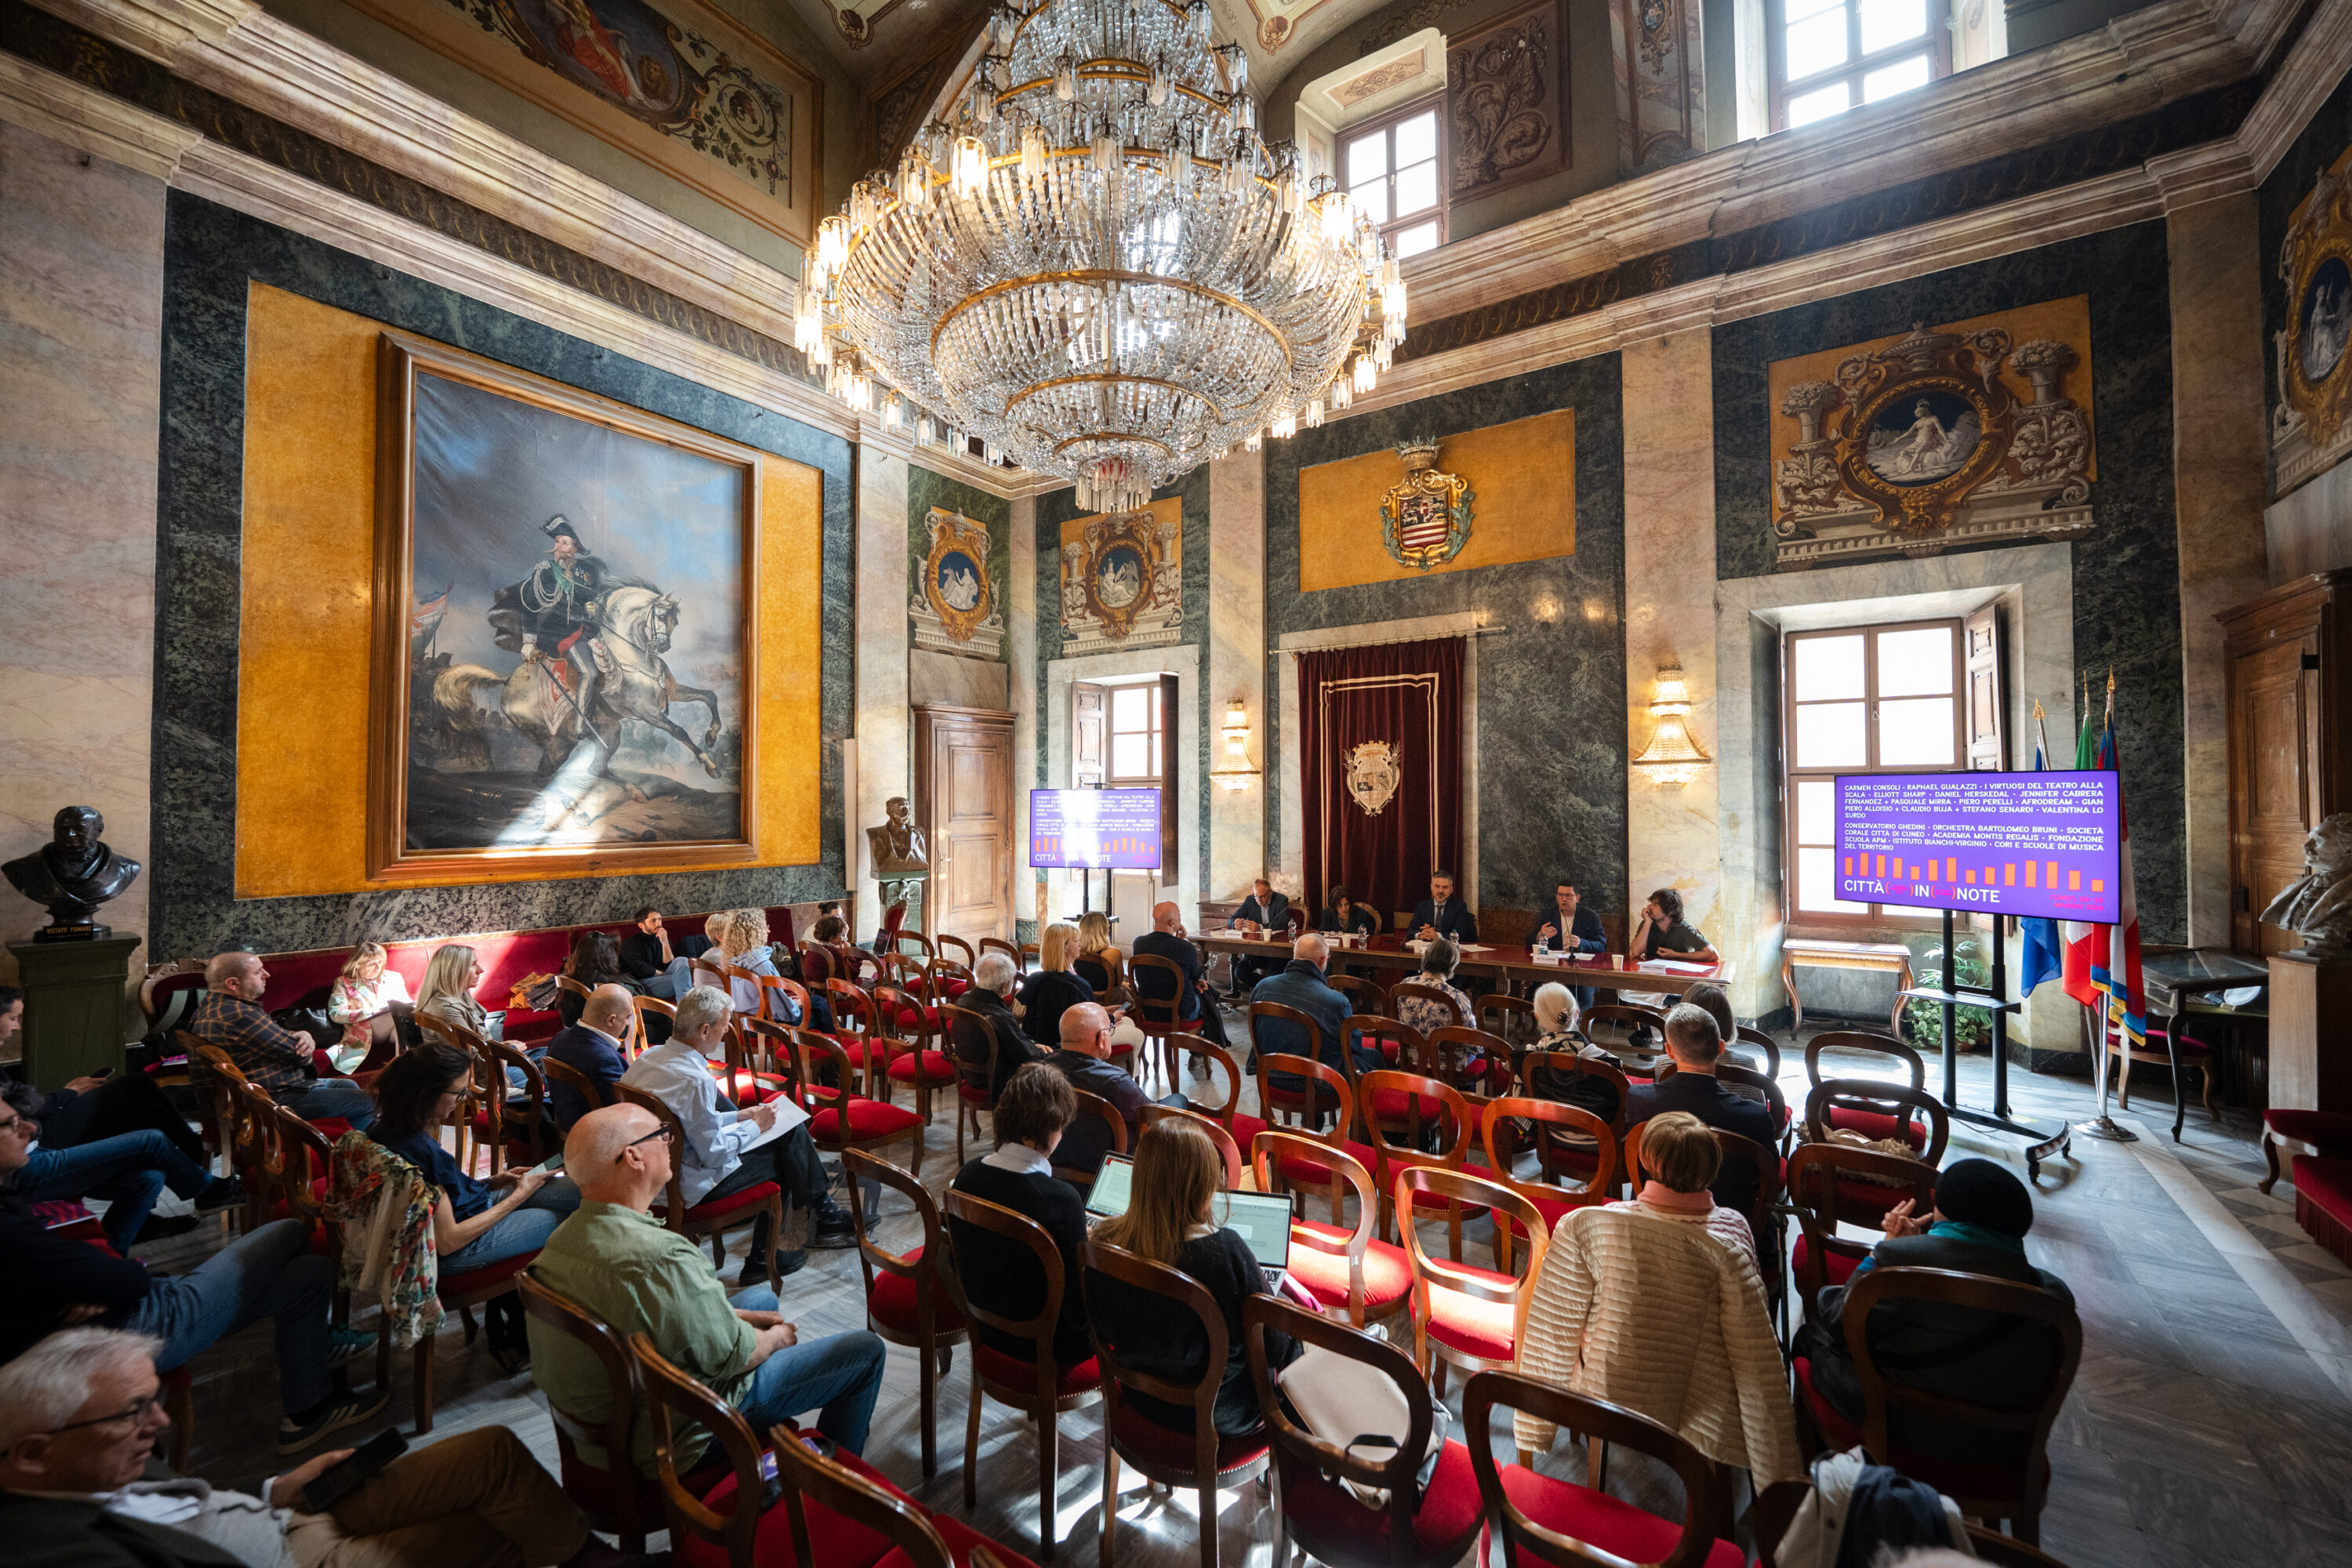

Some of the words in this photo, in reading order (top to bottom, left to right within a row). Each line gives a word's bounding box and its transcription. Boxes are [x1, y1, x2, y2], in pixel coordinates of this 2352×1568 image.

[1845, 880, 1885, 894] CITTÀ
[1915, 884, 1929, 897] IN
[1957, 887, 2000, 902] NOTE
